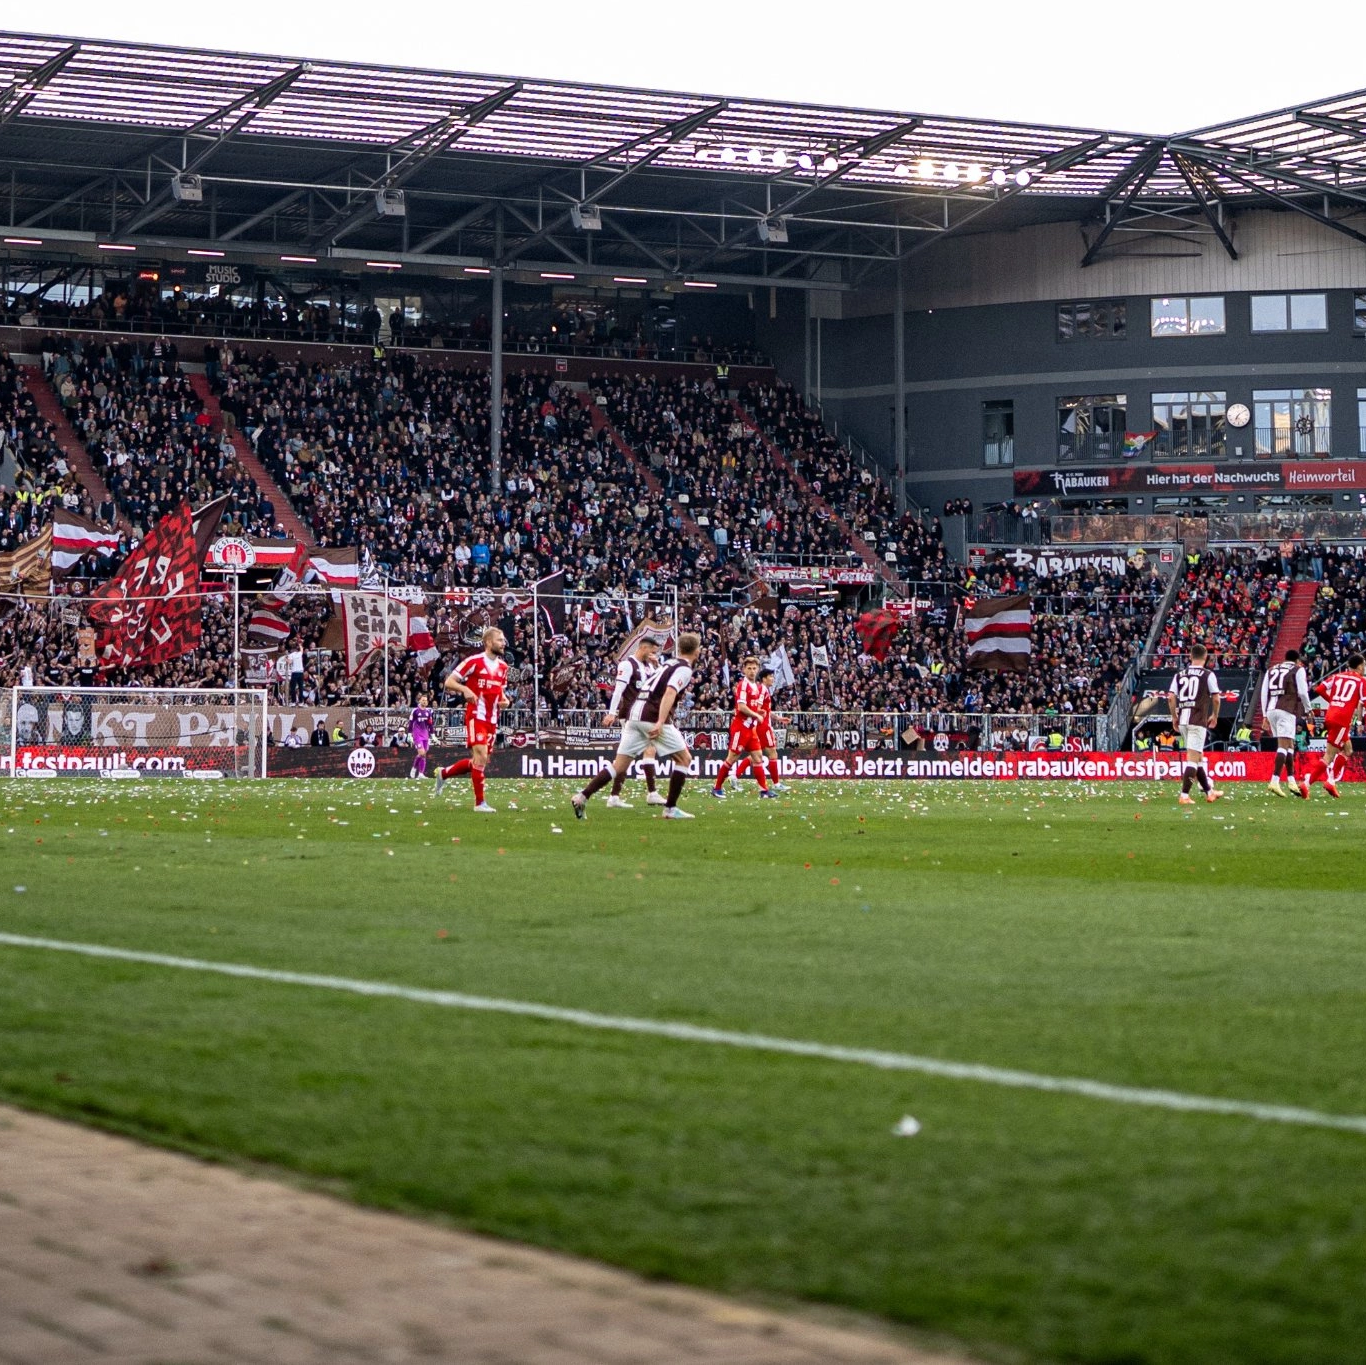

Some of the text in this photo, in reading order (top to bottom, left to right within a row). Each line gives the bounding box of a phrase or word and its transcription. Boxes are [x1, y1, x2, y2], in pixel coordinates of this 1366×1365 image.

[205, 273, 241, 283] STUDIO
[209, 265, 239, 275] MUSIC
[1147, 468, 1356, 485] Hier hat der Nachwuchs Heimvorteil
[1179, 676, 1200, 702] 20
[1269, 668, 1290, 690] 27
[1332, 678, 1357, 702] 10
[521, 755, 542, 776] In
[545, 755, 647, 780] Hambrg
[653, 755, 700, 776] wd
[854, 755, 904, 778] Jetzt
[906, 755, 1014, 777] anmelden:
